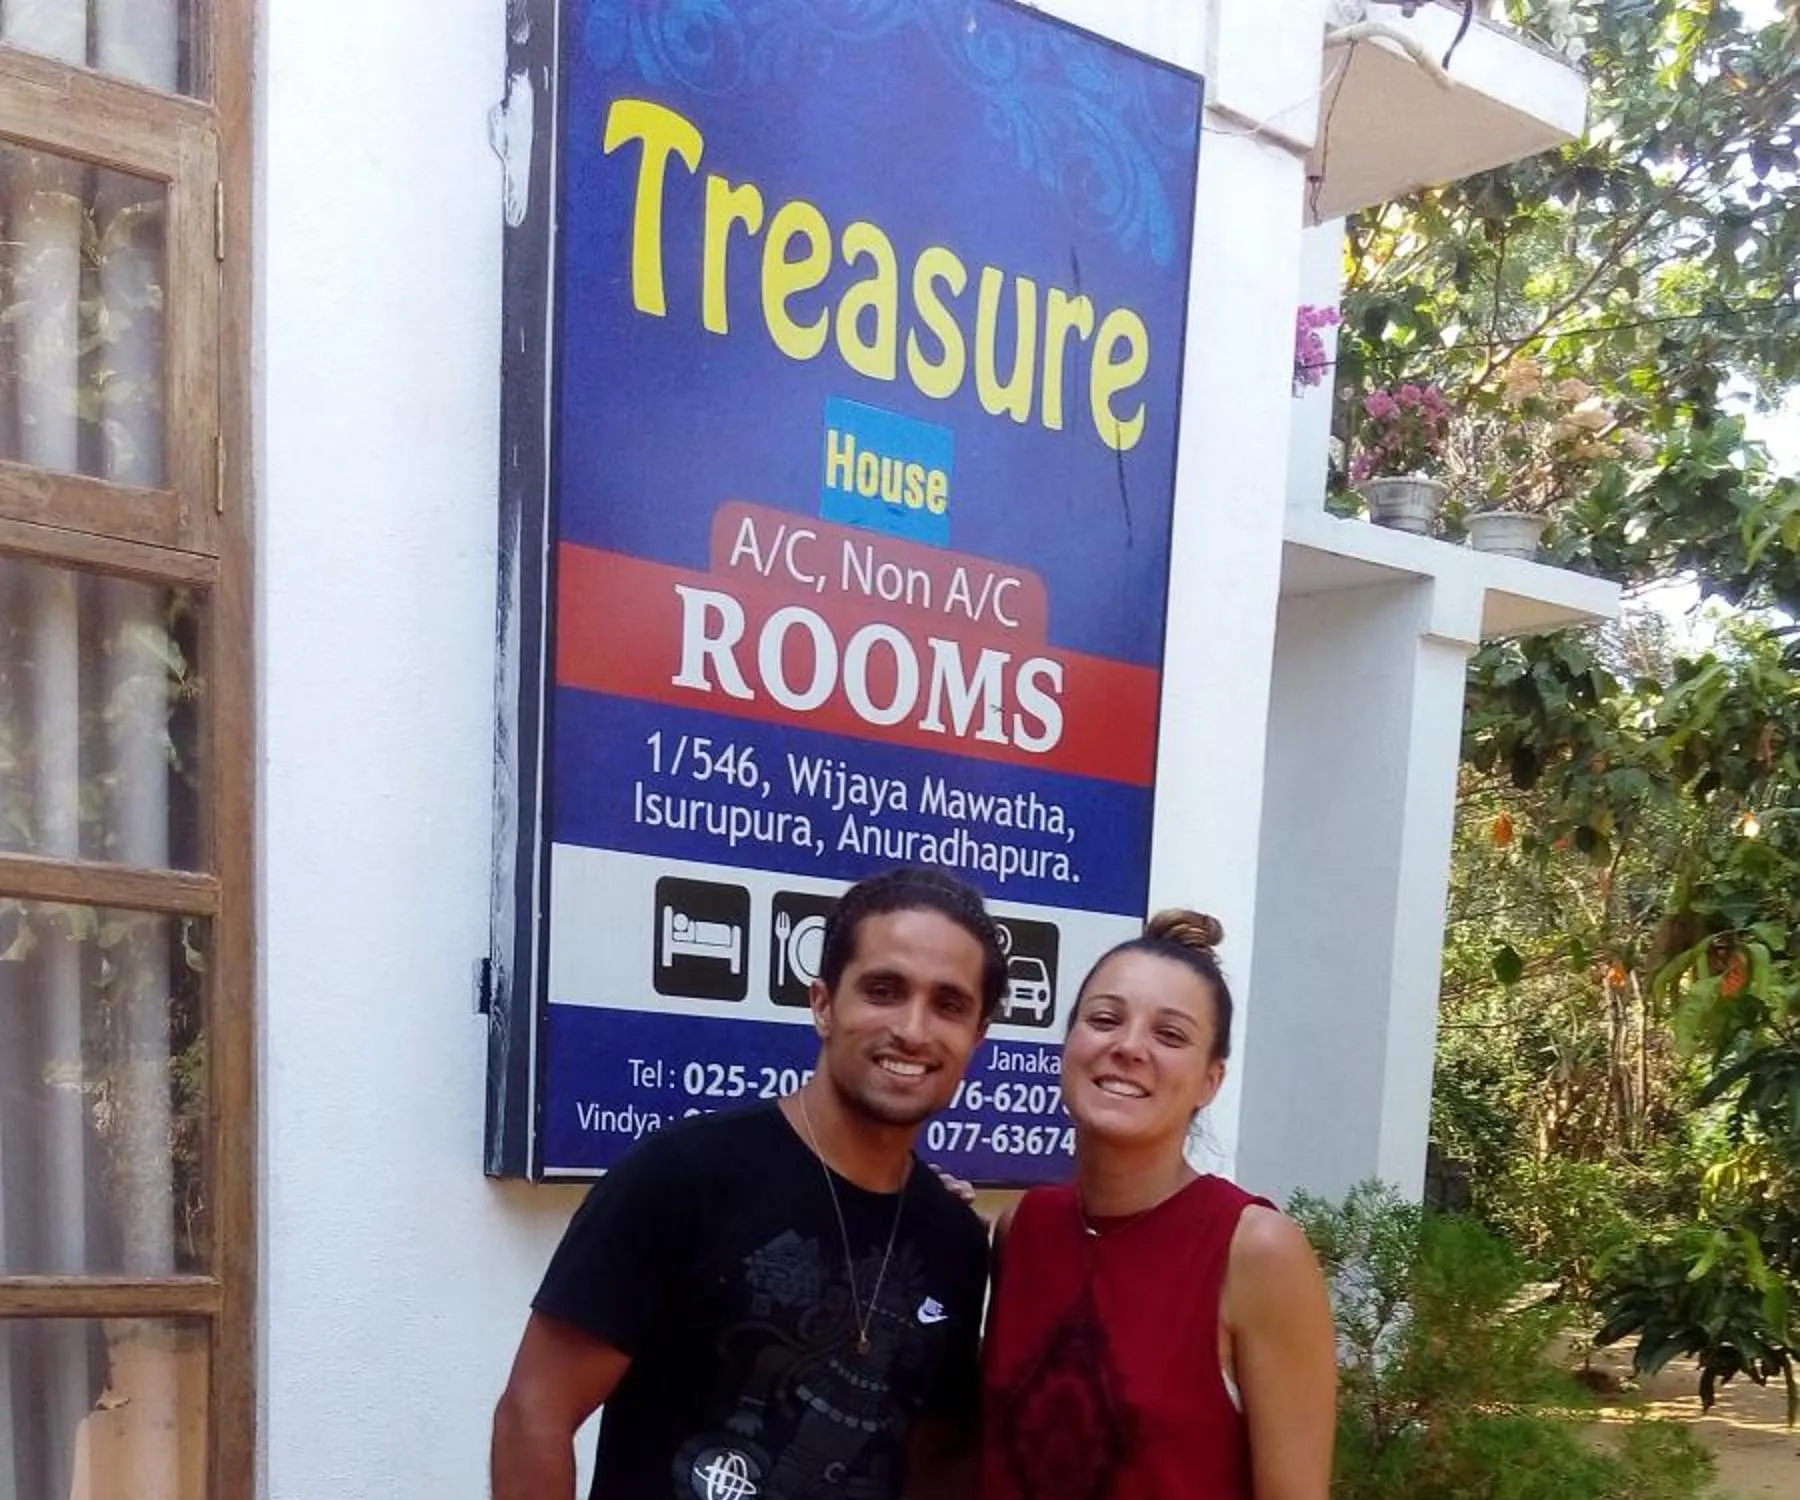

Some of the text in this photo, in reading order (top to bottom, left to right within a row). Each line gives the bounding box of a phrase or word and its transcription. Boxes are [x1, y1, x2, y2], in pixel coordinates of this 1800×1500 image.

[603, 97, 1149, 450] Treasure
[824, 429, 948, 515] House
[729, 516, 1022, 627] A/C, Non A/C
[671, 582, 1065, 754] ROOMS
[635, 781, 1080, 883] Isurupura, Anuradhapura.
[647, 731, 1075, 843] 1/546, Wijaya Mawatha,
[987, 1045, 1062, 1075] Janaka
